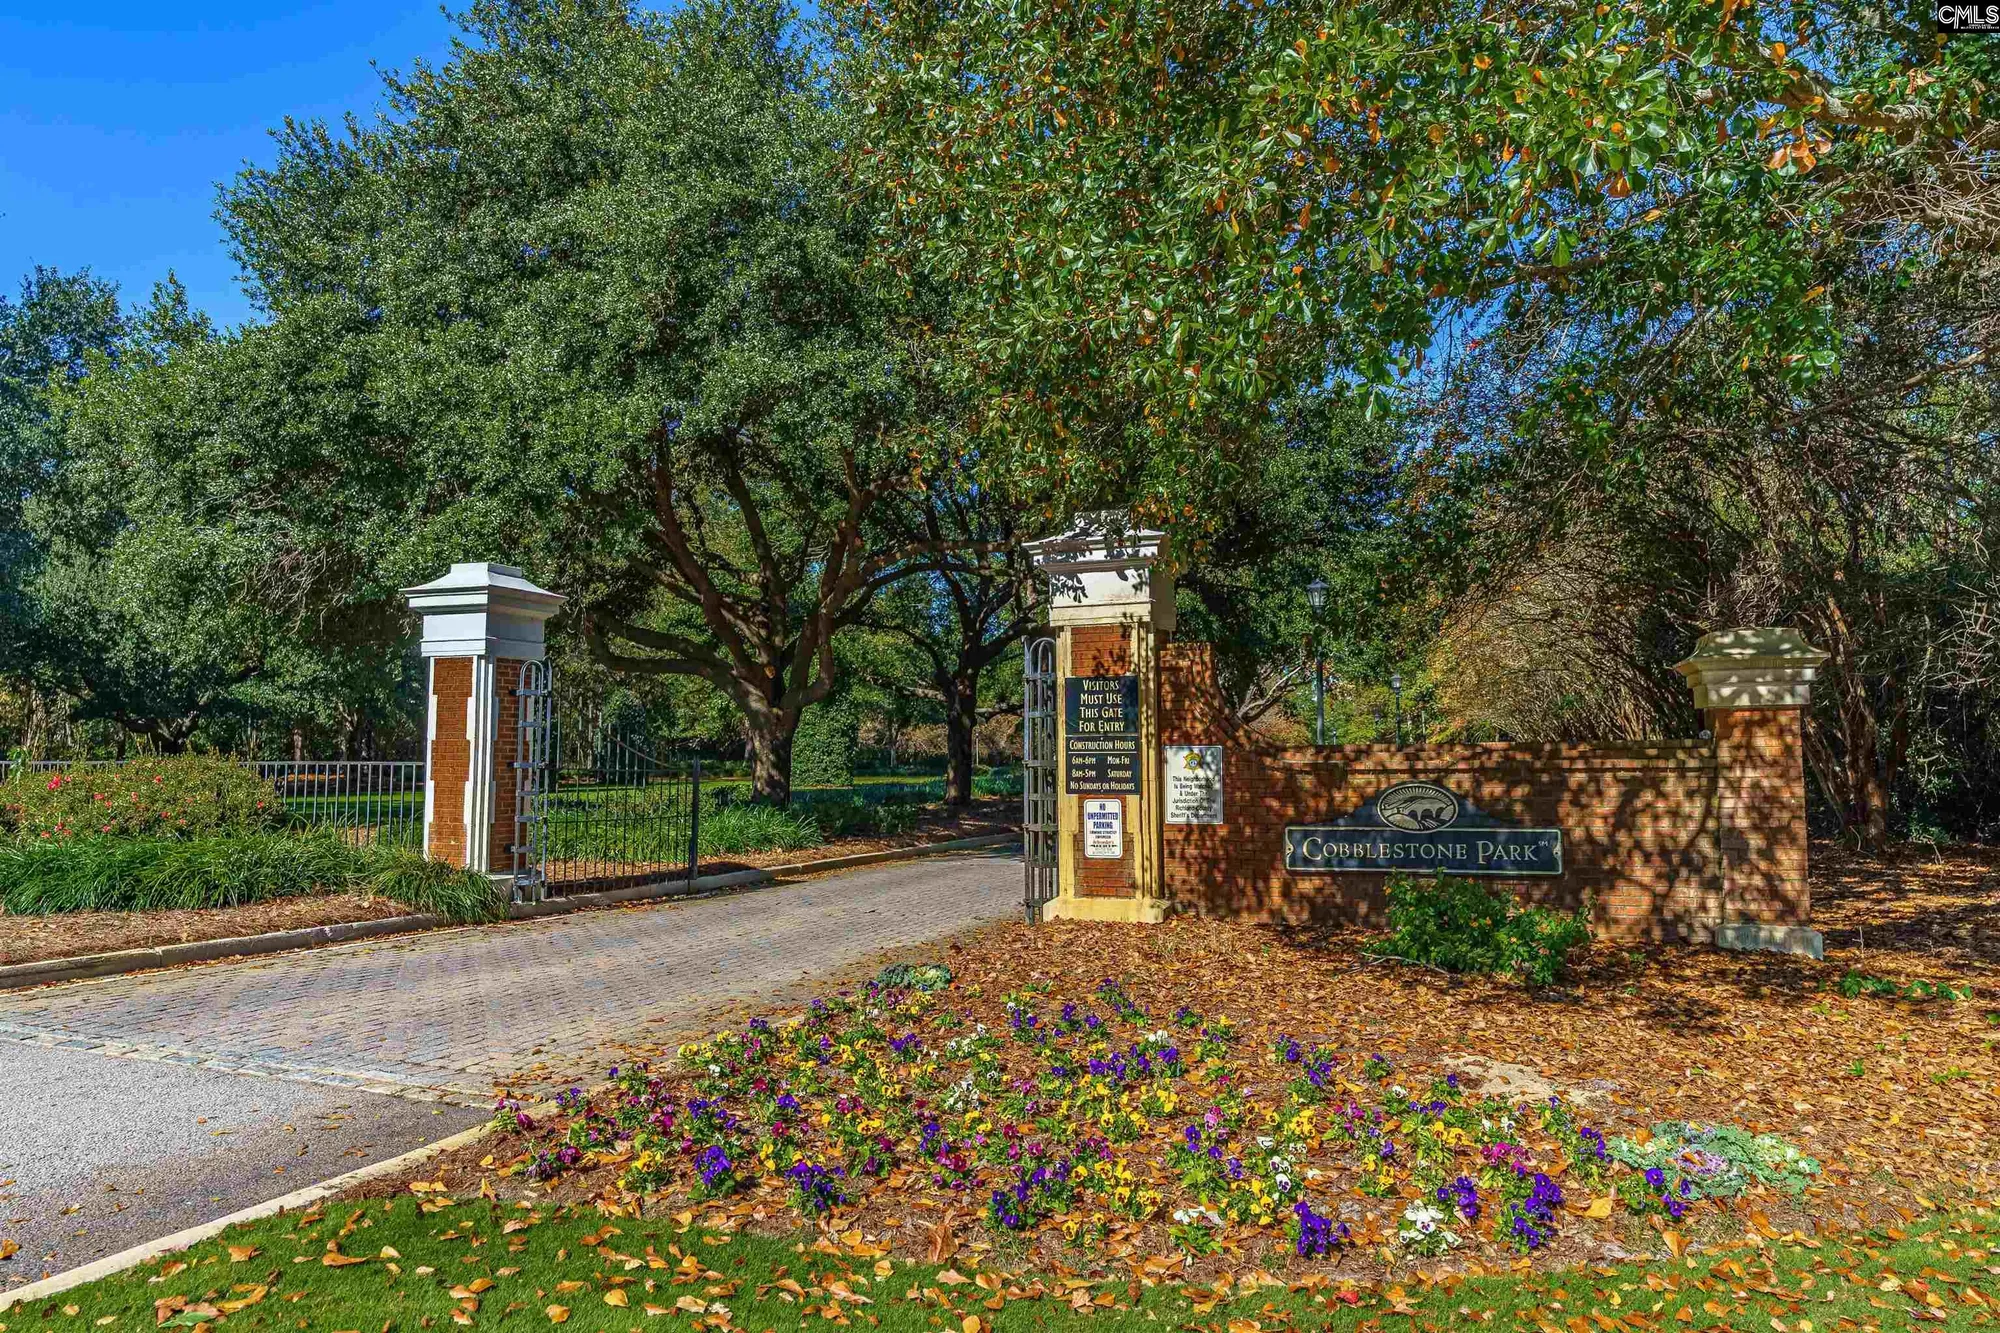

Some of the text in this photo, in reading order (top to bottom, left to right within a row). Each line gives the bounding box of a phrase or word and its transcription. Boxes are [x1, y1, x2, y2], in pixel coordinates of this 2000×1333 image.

[1083, 680, 1119, 690] VISITORS
[1080, 693, 1123, 704] MUST USE
[1079, 707, 1123, 718] THIS GATE
[1079, 720, 1125, 732] FOR ENTRY
[1070, 740, 1135, 750] CONSTRUCTION HOURS
[1107, 769, 1132, 777] SATURDAY
[1070, 781, 1135, 790] NO SUNDAYS OR HOLIDAYS
[1087, 812, 1119, 820] UNPERMITTED
[1093, 821, 1113, 829] PARKING
[1302, 837, 1467, 860] COBBLESTONE
[1476, 840, 1538, 864] PARK
